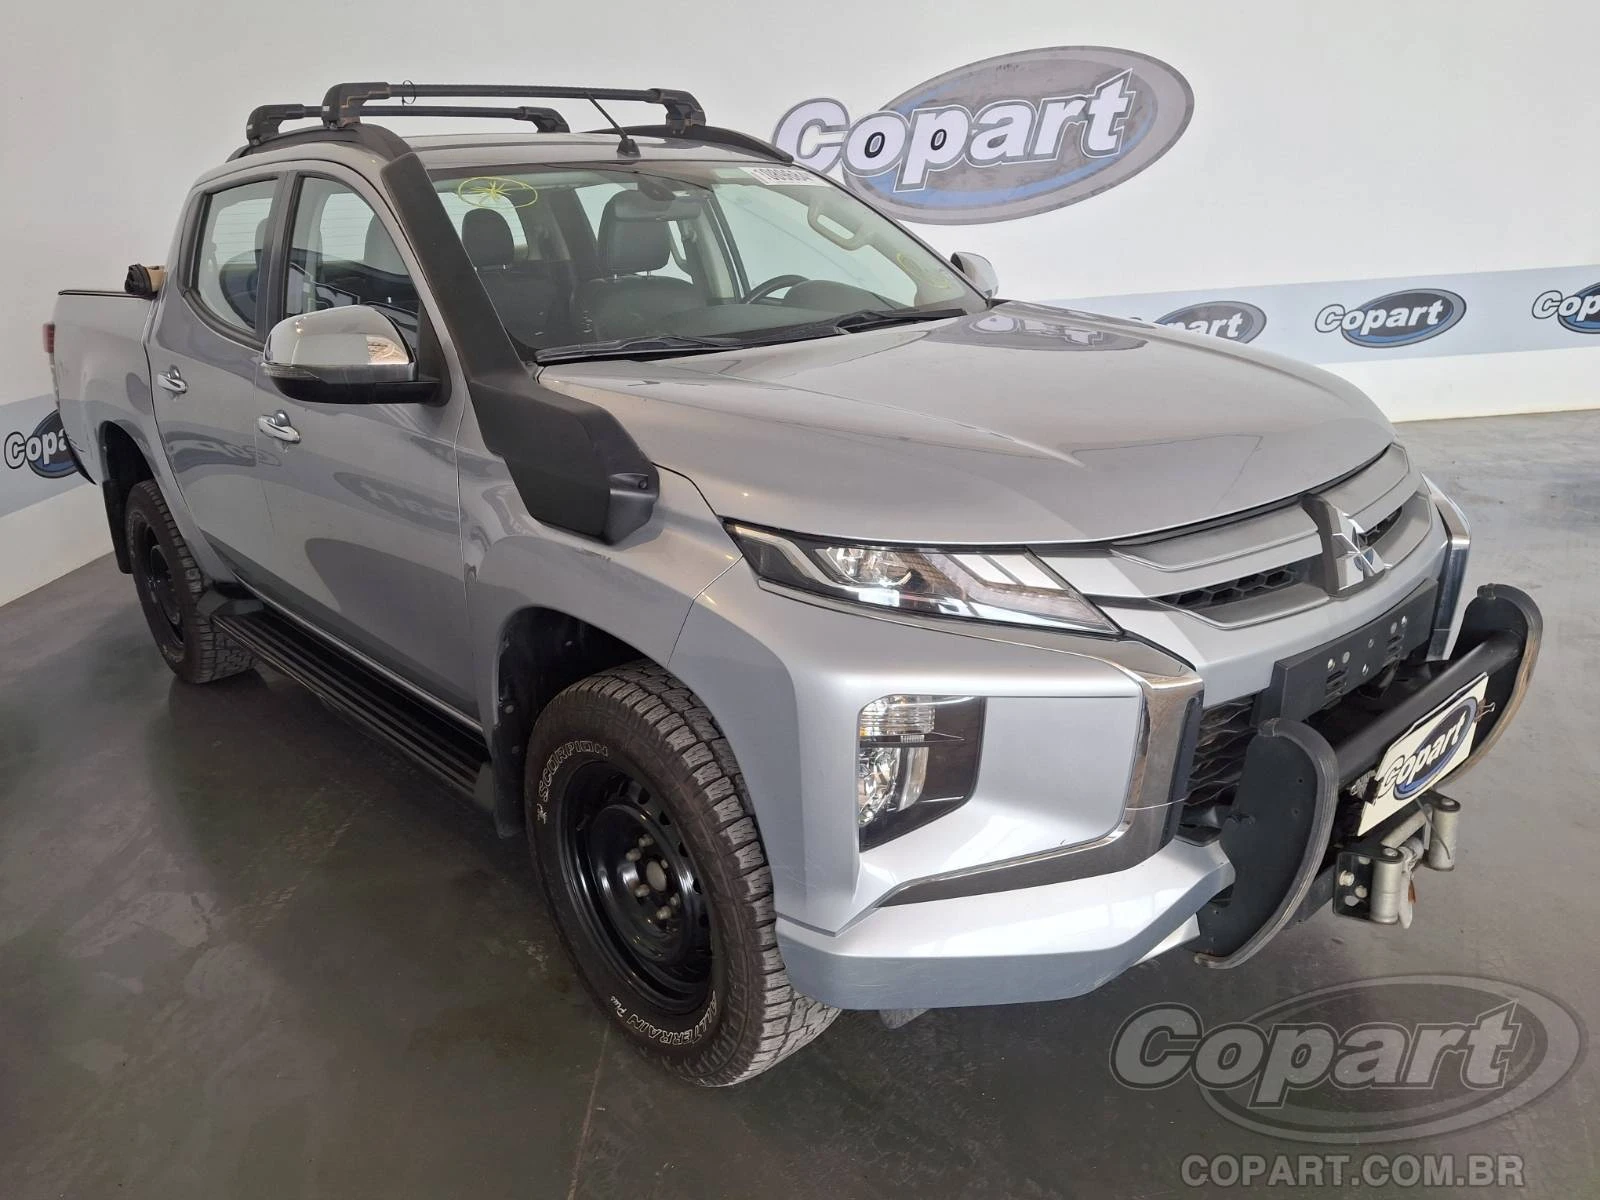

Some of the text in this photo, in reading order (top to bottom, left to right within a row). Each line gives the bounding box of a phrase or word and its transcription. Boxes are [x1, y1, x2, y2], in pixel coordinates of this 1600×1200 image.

[772, 68, 1137, 193] Copart
[1315, 299, 1444, 337] Copart
[538, 740, 609, 802] SCORPION
[1379, 710, 1468, 798] Copart
